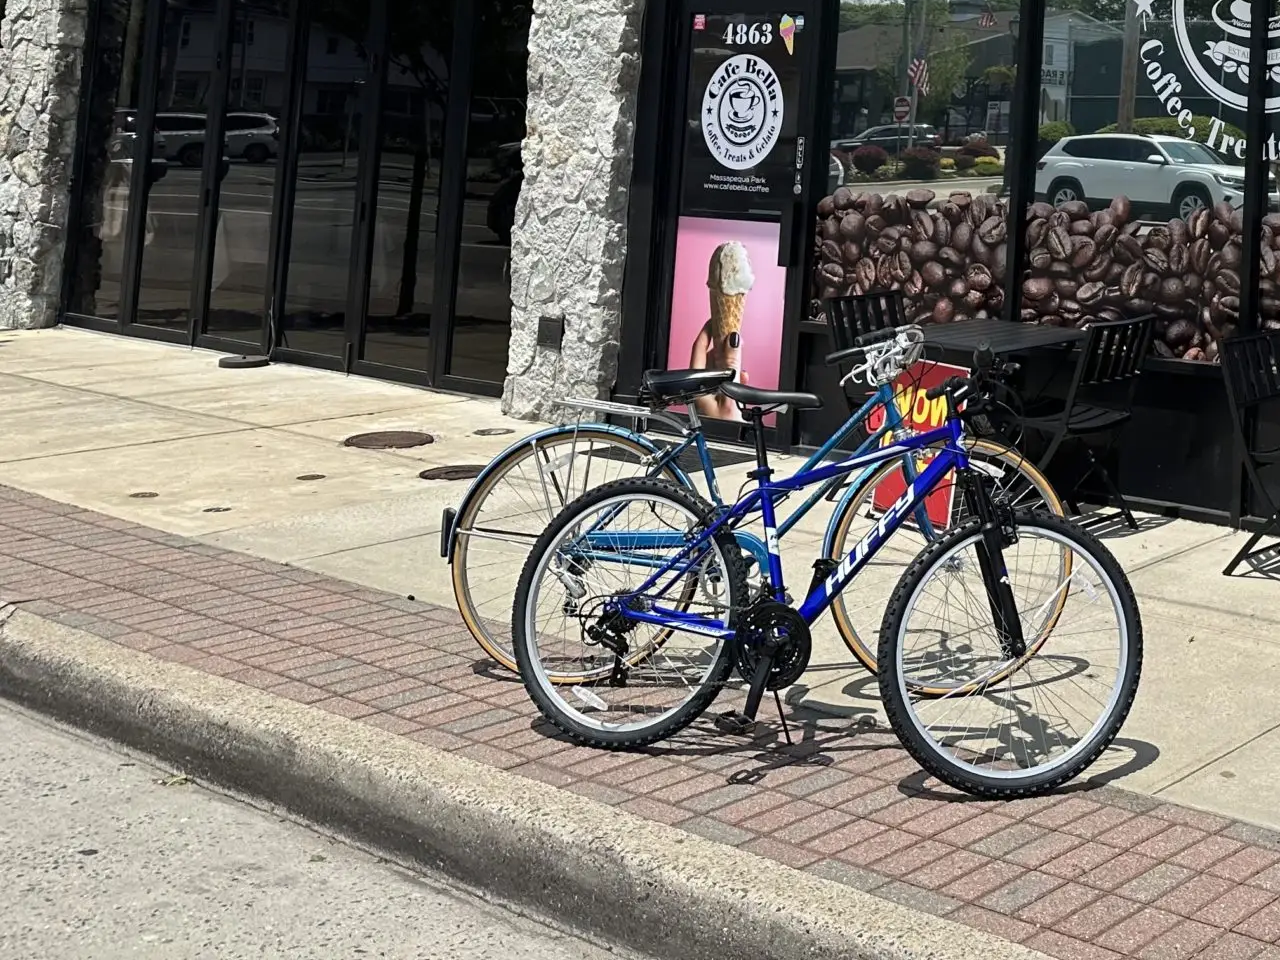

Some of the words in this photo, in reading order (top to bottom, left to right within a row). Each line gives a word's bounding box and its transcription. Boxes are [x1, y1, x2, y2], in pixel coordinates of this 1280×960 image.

[722, 23, 773, 45] 4863
[709, 62, 740, 99] Cafe
[745, 58, 778, 103] Bella
[723, 148, 747, 163] Treats
[755, 125, 776, 154] Gelato
[751, 175, 767, 184] Park
[825, 483, 915, 597] HUFFY
